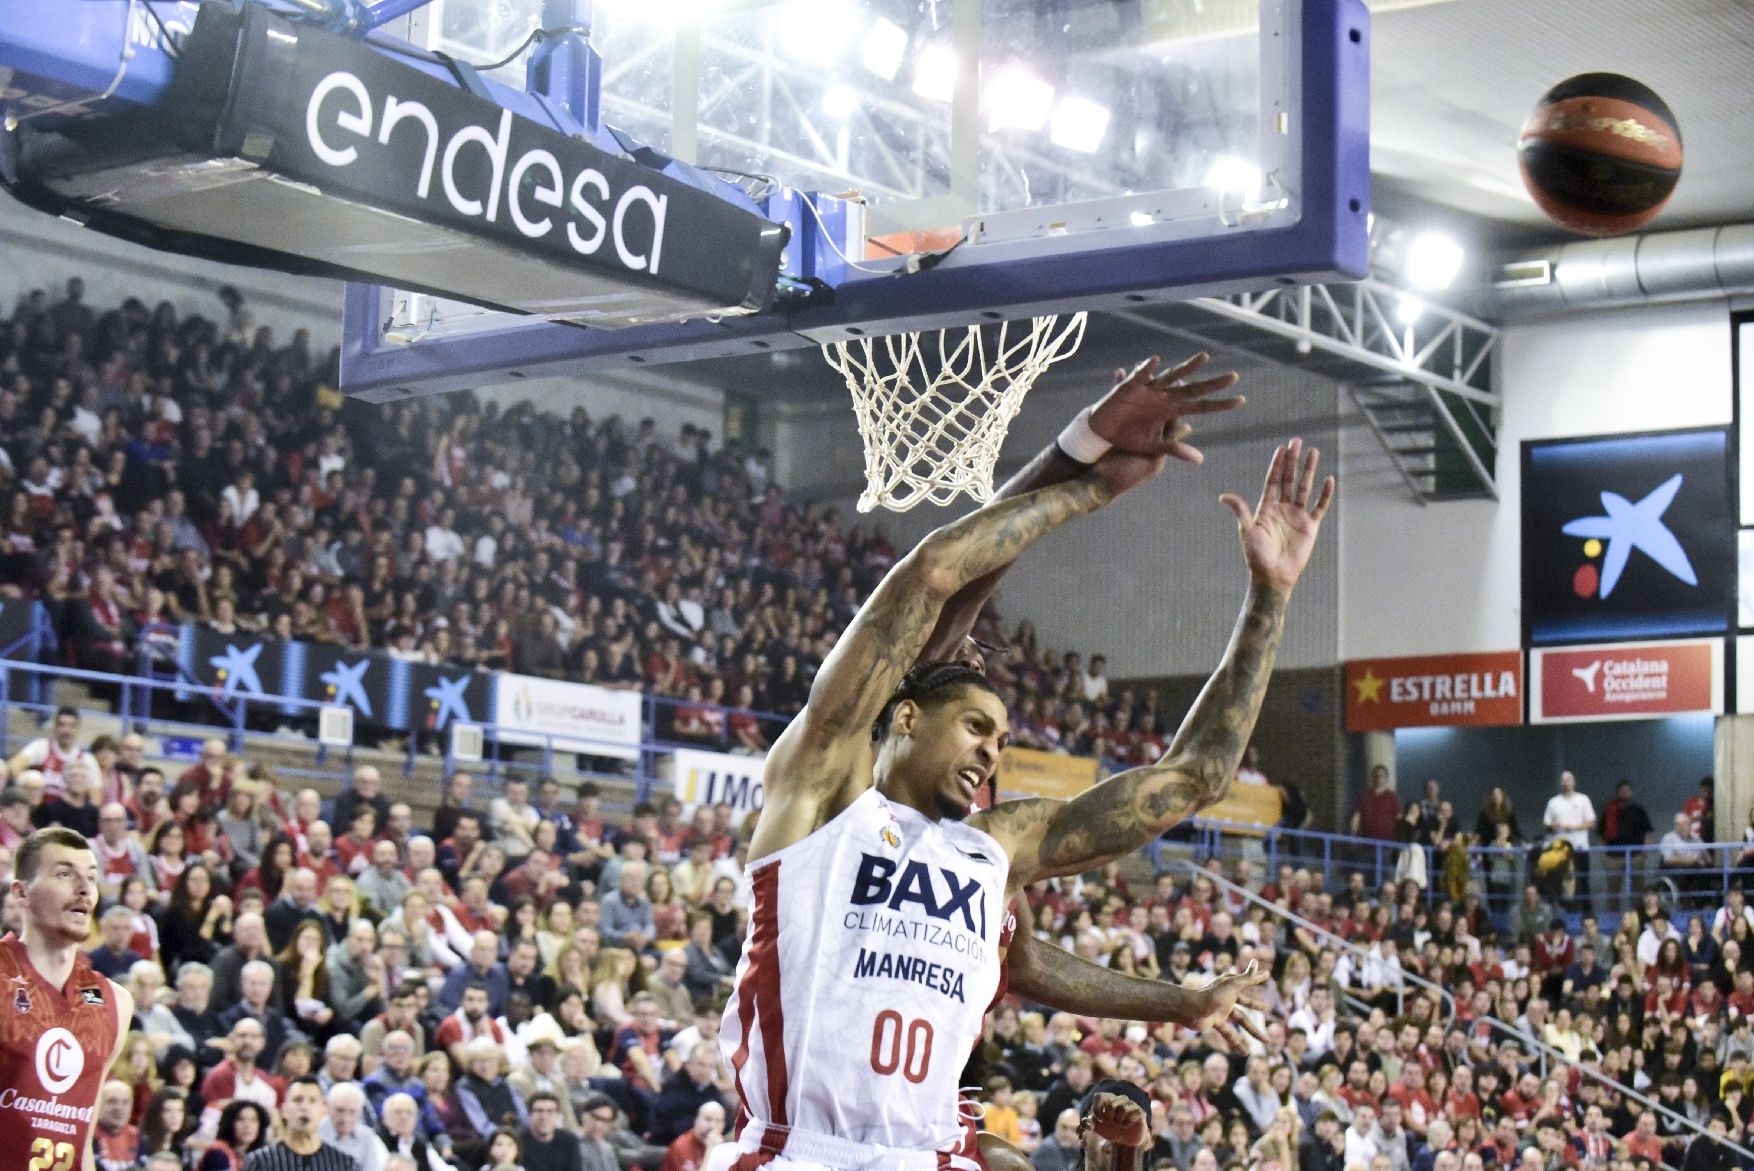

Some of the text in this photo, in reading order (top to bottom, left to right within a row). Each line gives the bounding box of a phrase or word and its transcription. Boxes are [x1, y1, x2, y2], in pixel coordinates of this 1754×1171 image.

[305, 71, 668, 275] endesa
[1390, 670, 1517, 703] ESTRELLA
[850, 852, 986, 942] BAXI
[843, 911, 988, 964] CLIMATIZACIÓN
[853, 948, 965, 1003] MANRESA
[870, 1009, 934, 1084] 00
